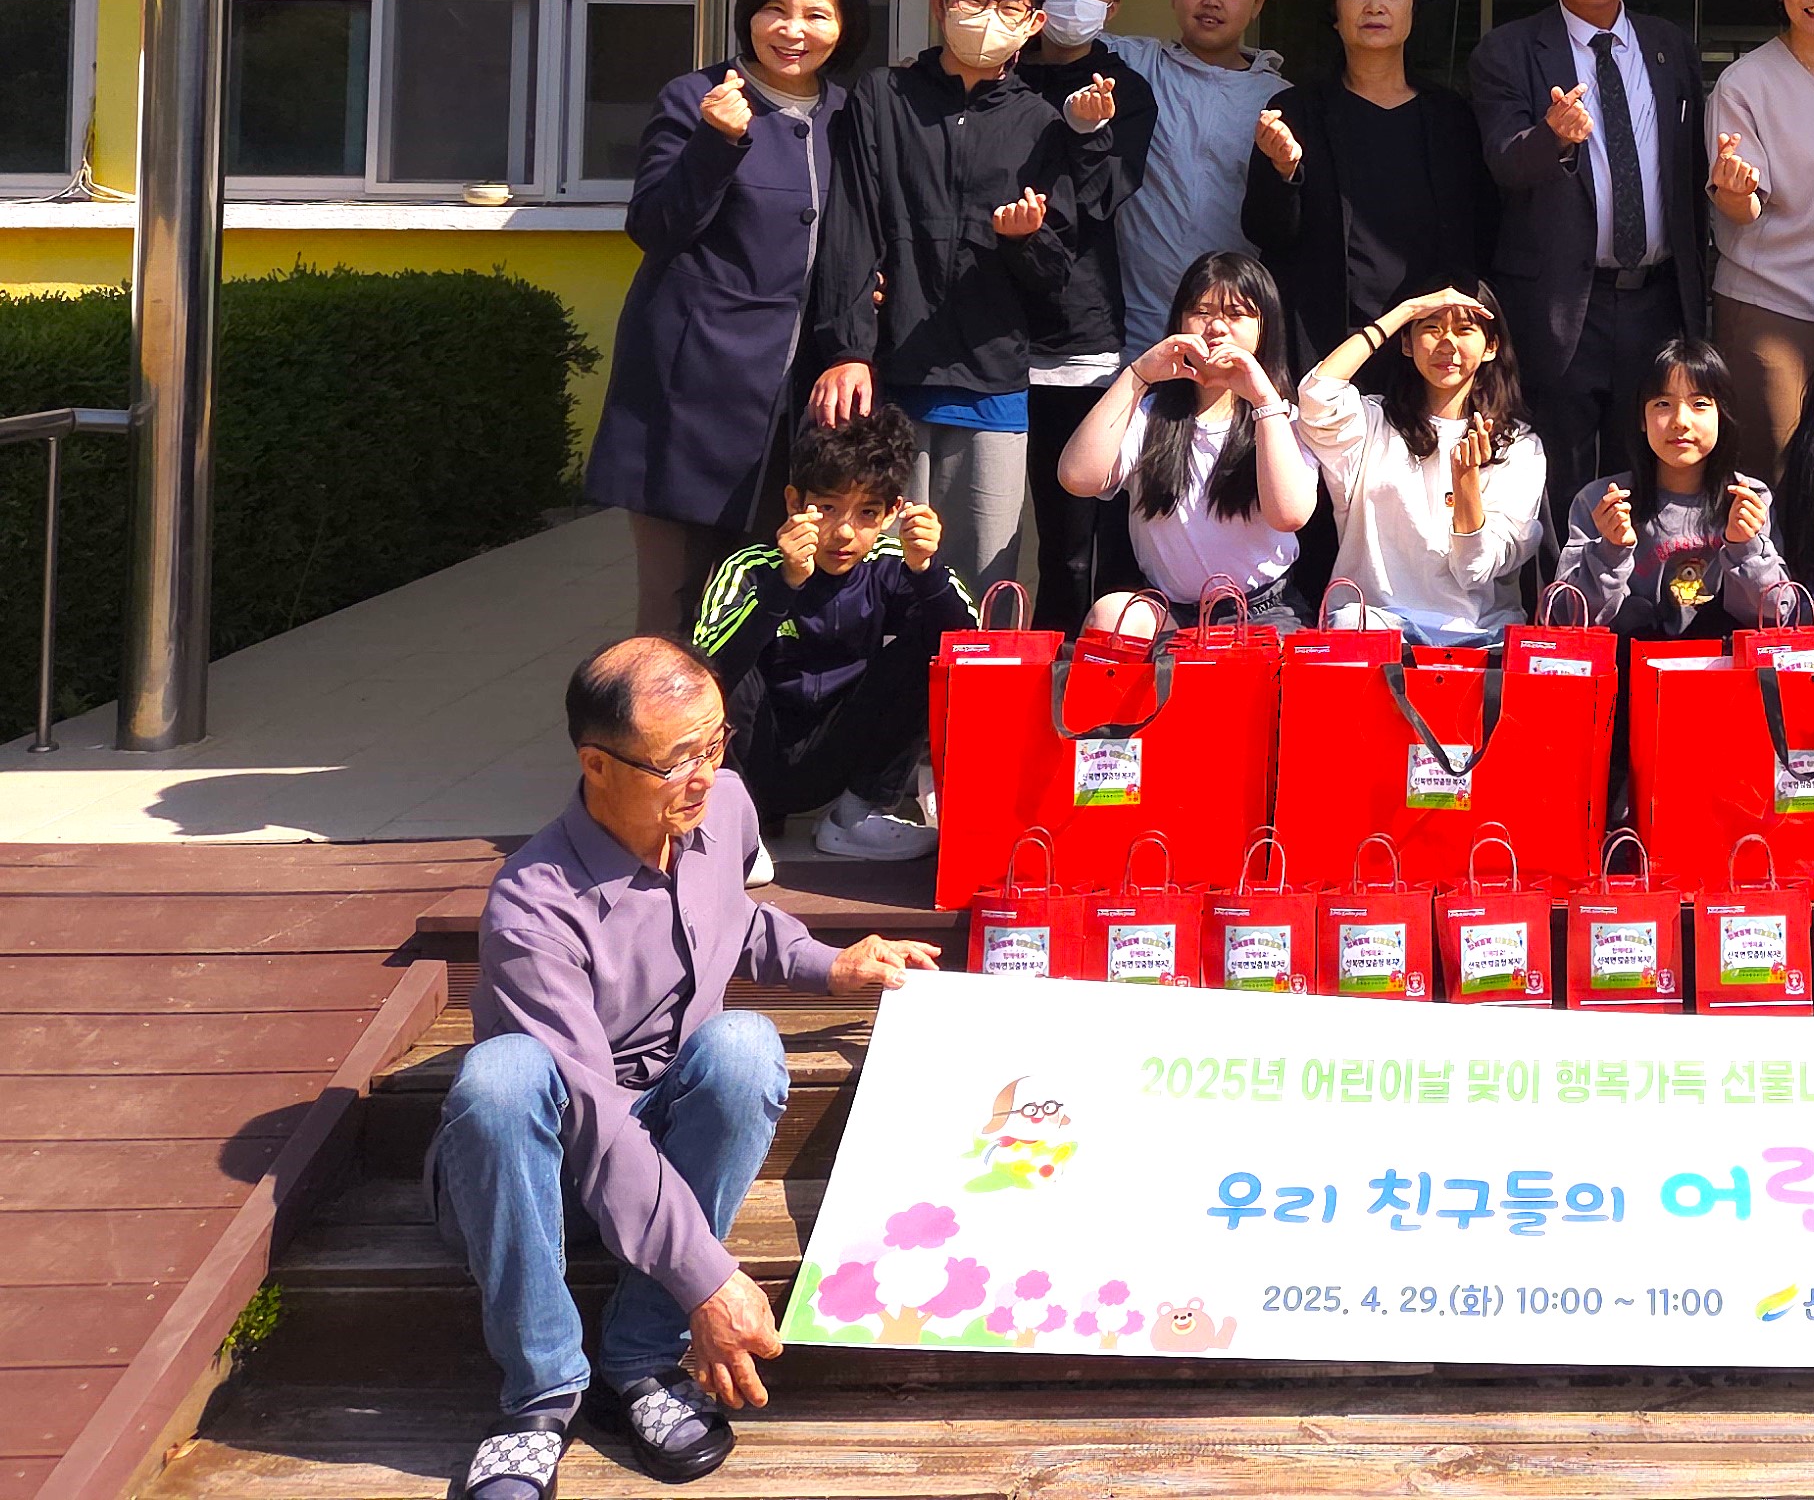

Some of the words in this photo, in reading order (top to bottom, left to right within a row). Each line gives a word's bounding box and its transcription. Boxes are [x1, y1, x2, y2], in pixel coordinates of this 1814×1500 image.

[1143, 1057, 1285, 1100] 2025년
[1302, 1060, 1453, 1103] 어린이날
[1469, 1060, 1539, 1102] 맞이
[1557, 1061, 1705, 1102] 행복가득
[1207, 1172, 1337, 1230] 우리
[1368, 1169, 1625, 1236] 친구들의
[1263, 1286, 1349, 1315] 2025.
[1360, 1286, 1387, 1315] 4.
[1517, 1287, 1602, 1315] 10:00
[1648, 1289, 1722, 1316] 11:00
